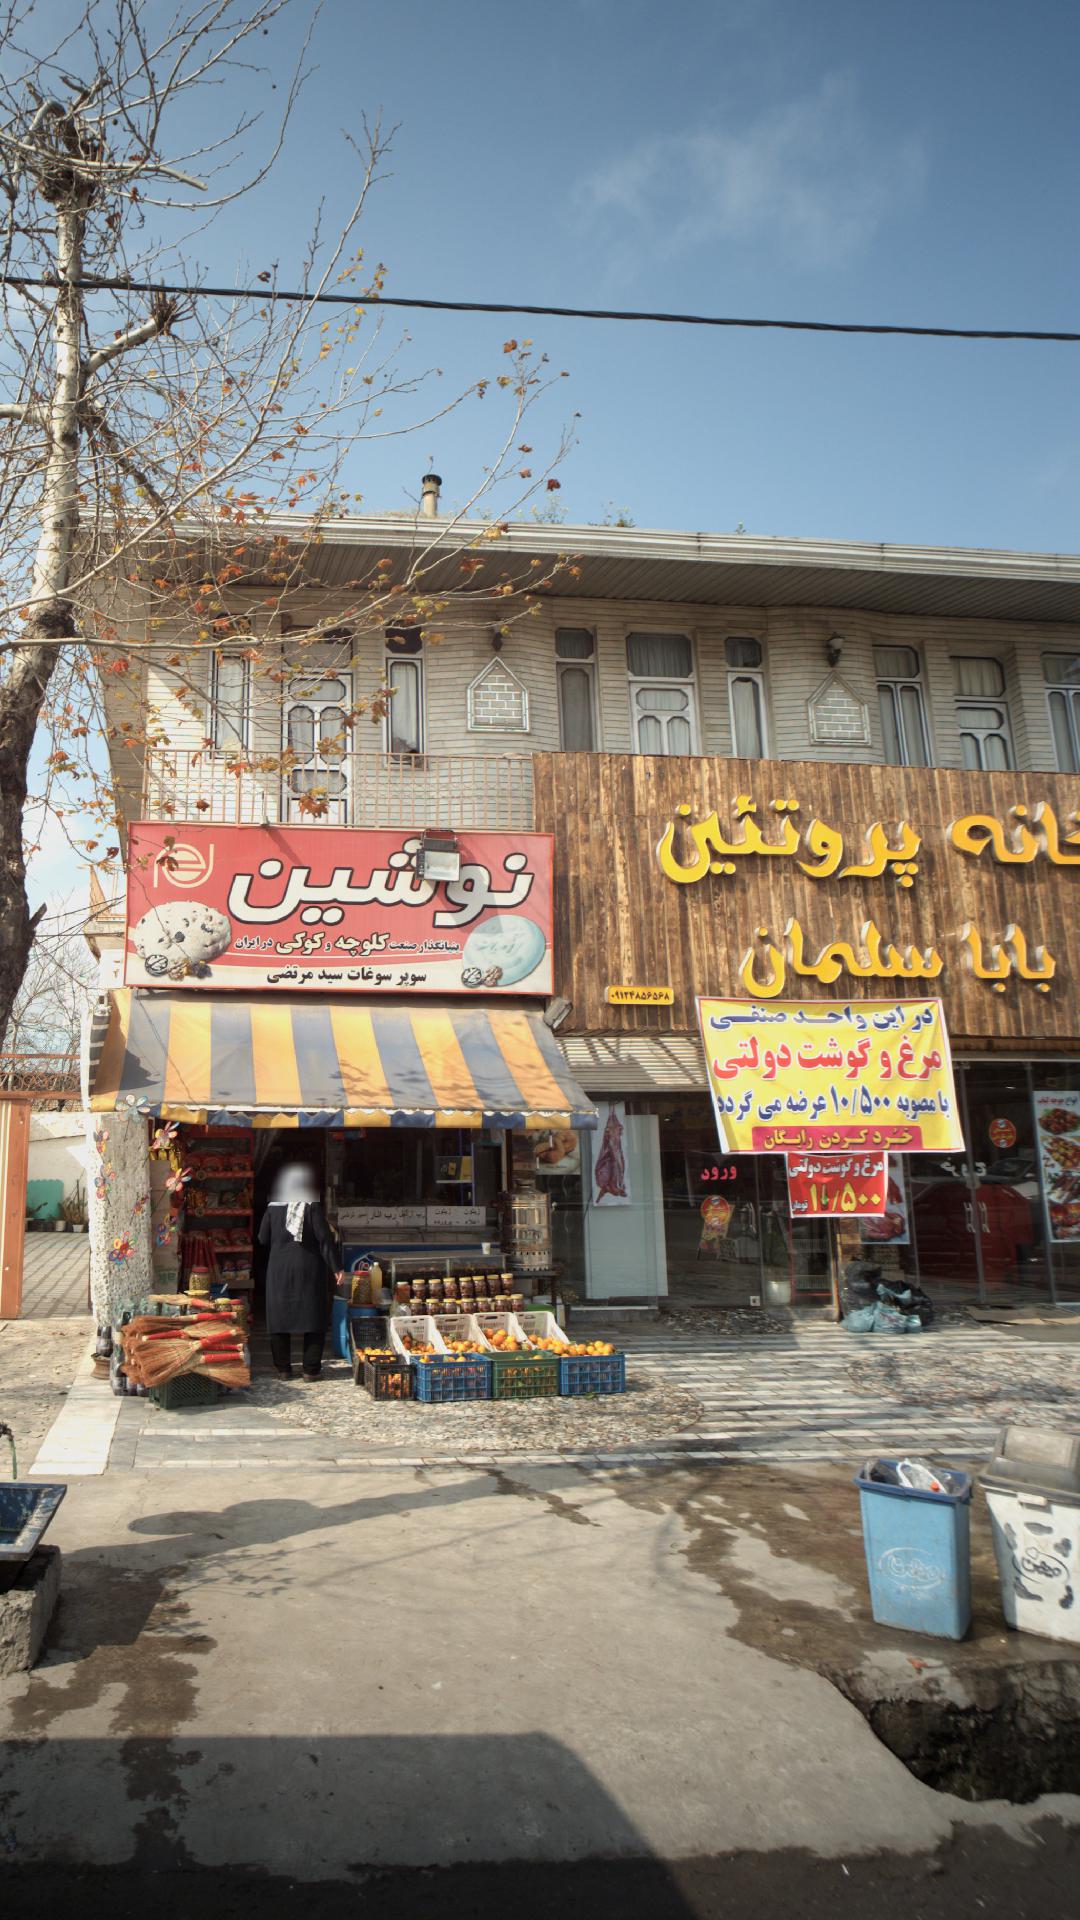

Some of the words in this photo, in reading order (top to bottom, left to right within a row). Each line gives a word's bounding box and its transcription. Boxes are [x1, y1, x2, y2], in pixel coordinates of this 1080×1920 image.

[656, 794, 922, 888] پروتئین
[228, 837, 535, 928] نوشین
[235, 936, 260, 949] ایران
[260, 938, 273, 949] در
[275, 931, 325, 955] کوکی
[324, 941, 332, 952] و
[334, 931, 390, 957] کلوچه
[389, 941, 417, 950] صنعت
[739, 917, 944, 998] سلمان
[960, 922, 1056, 992] بابا
[266, 964, 314, 984] مرتضی
[318, 969, 343, 983] سید
[347, 966, 392, 985] سوغات
[396, 972, 427, 988] سوپر
[710, 1004, 787, 1030] صنفی
[793, 1005, 868, 1030] واحد
[873, 1005, 905, 1030] این
[911, 1008, 933, 1031] در
[713, 1036, 792, 1080] دولتی
[797, 1038, 871, 1079] گوشت
[880, 1050, 892, 1079] و
[897, 1035, 942, 1079] مرغ
[717, 1089, 753, 1121] گردد
[758, 1099, 782, 1120] می
[786, 1090, 827, 1120] عرضه
[830, 1084, 890, 1114] ۱۰/۵۰۰
[897, 1095, 936, 1120] مصوبه
[937, 1089, 951, 1118] با
[764, 1128, 813, 1150] رایگان
[819, 1129, 868, 1149] کردن
[701, 1165, 738, 1180] ورود
[788, 1158, 821, 1179] دولتی
[821, 1158, 853, 1178] گوشت
[852, 1162, 860, 1177] و
[861, 1156, 884, 1177] مرغ
[810, 1182, 881, 1212] ۱/۵۰۰
